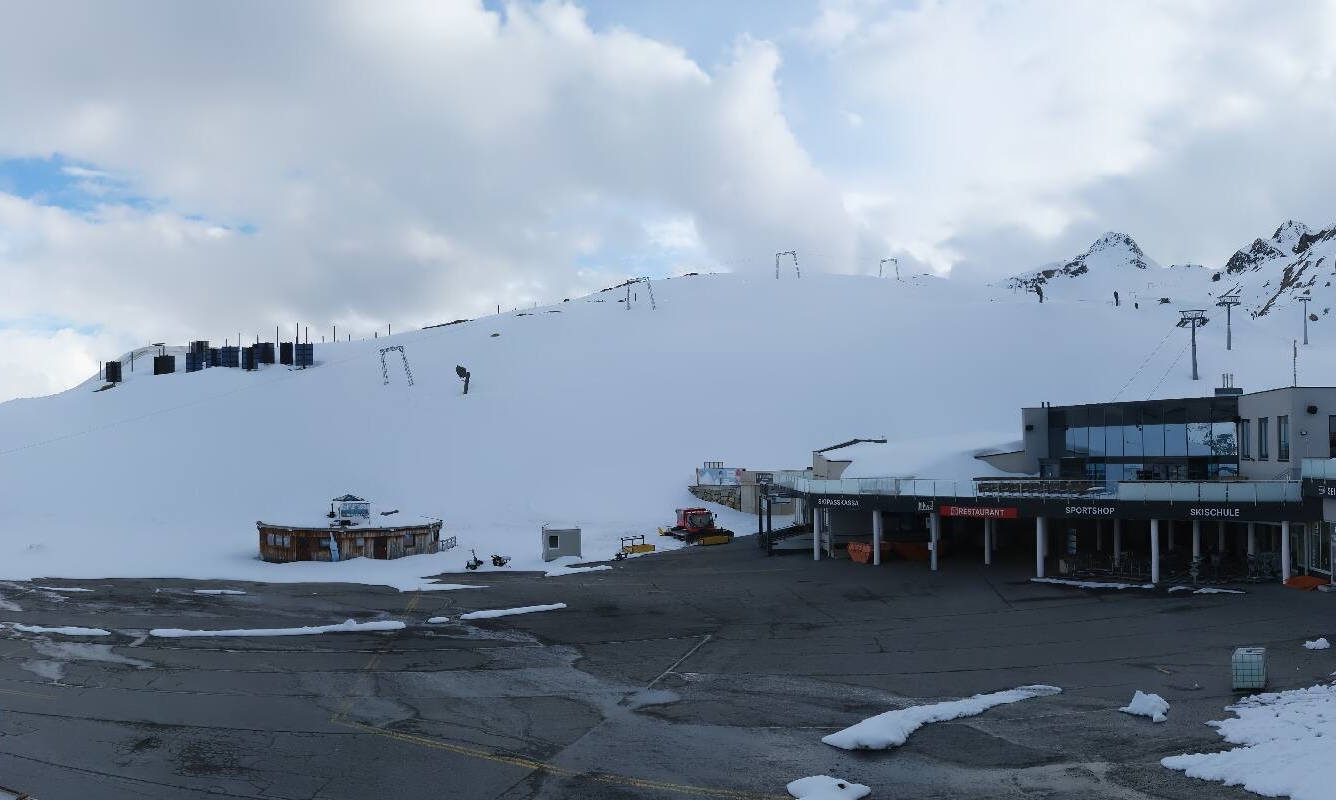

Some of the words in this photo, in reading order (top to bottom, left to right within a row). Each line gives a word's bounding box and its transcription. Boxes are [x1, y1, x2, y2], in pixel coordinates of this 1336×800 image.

[958, 507, 1005, 516] RESTAURANT
[1065, 506, 1115, 515] SPORTSHOP
[1190, 508, 1240, 517] SKISCHULE
